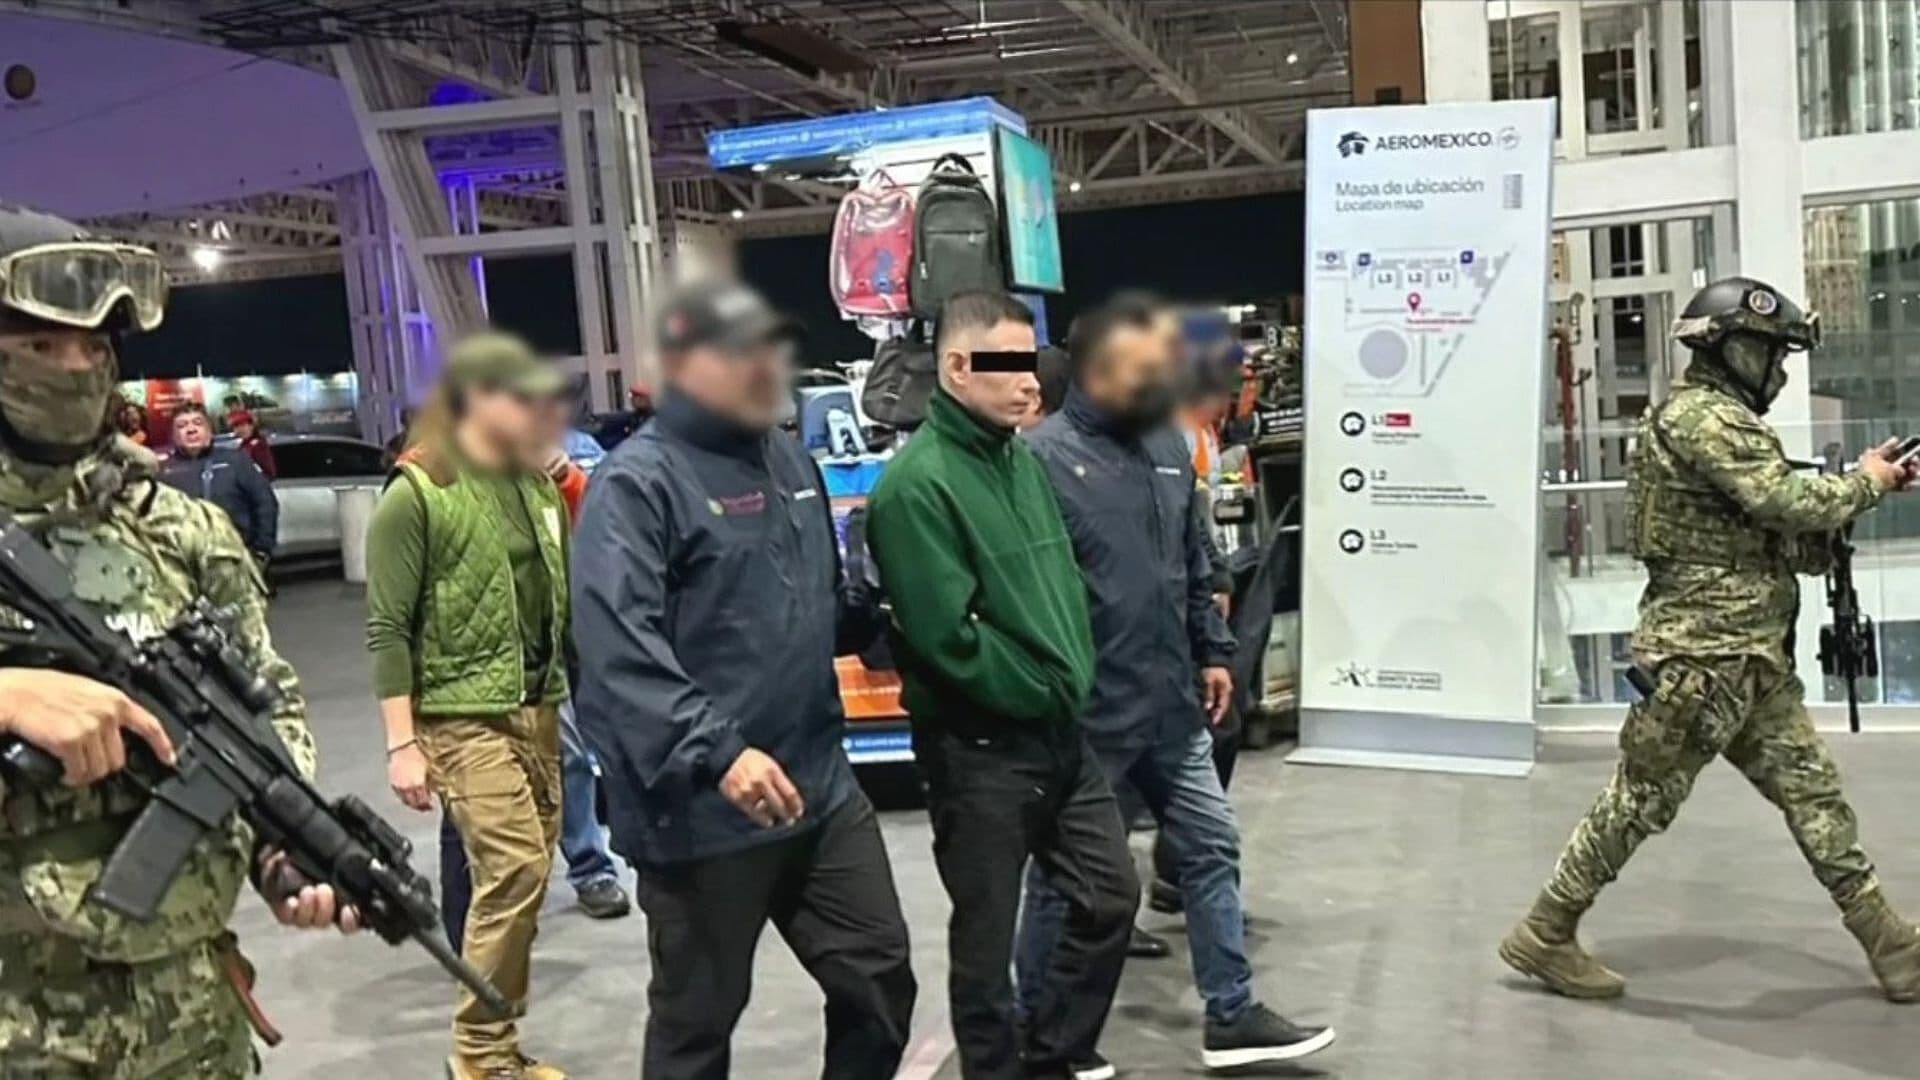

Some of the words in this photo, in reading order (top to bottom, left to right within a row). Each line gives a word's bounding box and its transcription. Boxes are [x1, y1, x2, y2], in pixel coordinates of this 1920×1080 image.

[1375, 132, 1491, 150] AEROMEXICO
[1335, 182, 1379, 198] Mapa
[1382, 180, 1402, 195] de
[1405, 176, 1484, 194] ubicación
[1335, 200, 1391, 212] Location
[1394, 199, 1424, 211] map
[1408, 273, 1423, 283] L2
[1437, 272, 1451, 283] L1
[1371, 470, 1387, 480] L2
[1370, 529, 1386, 540] L3
